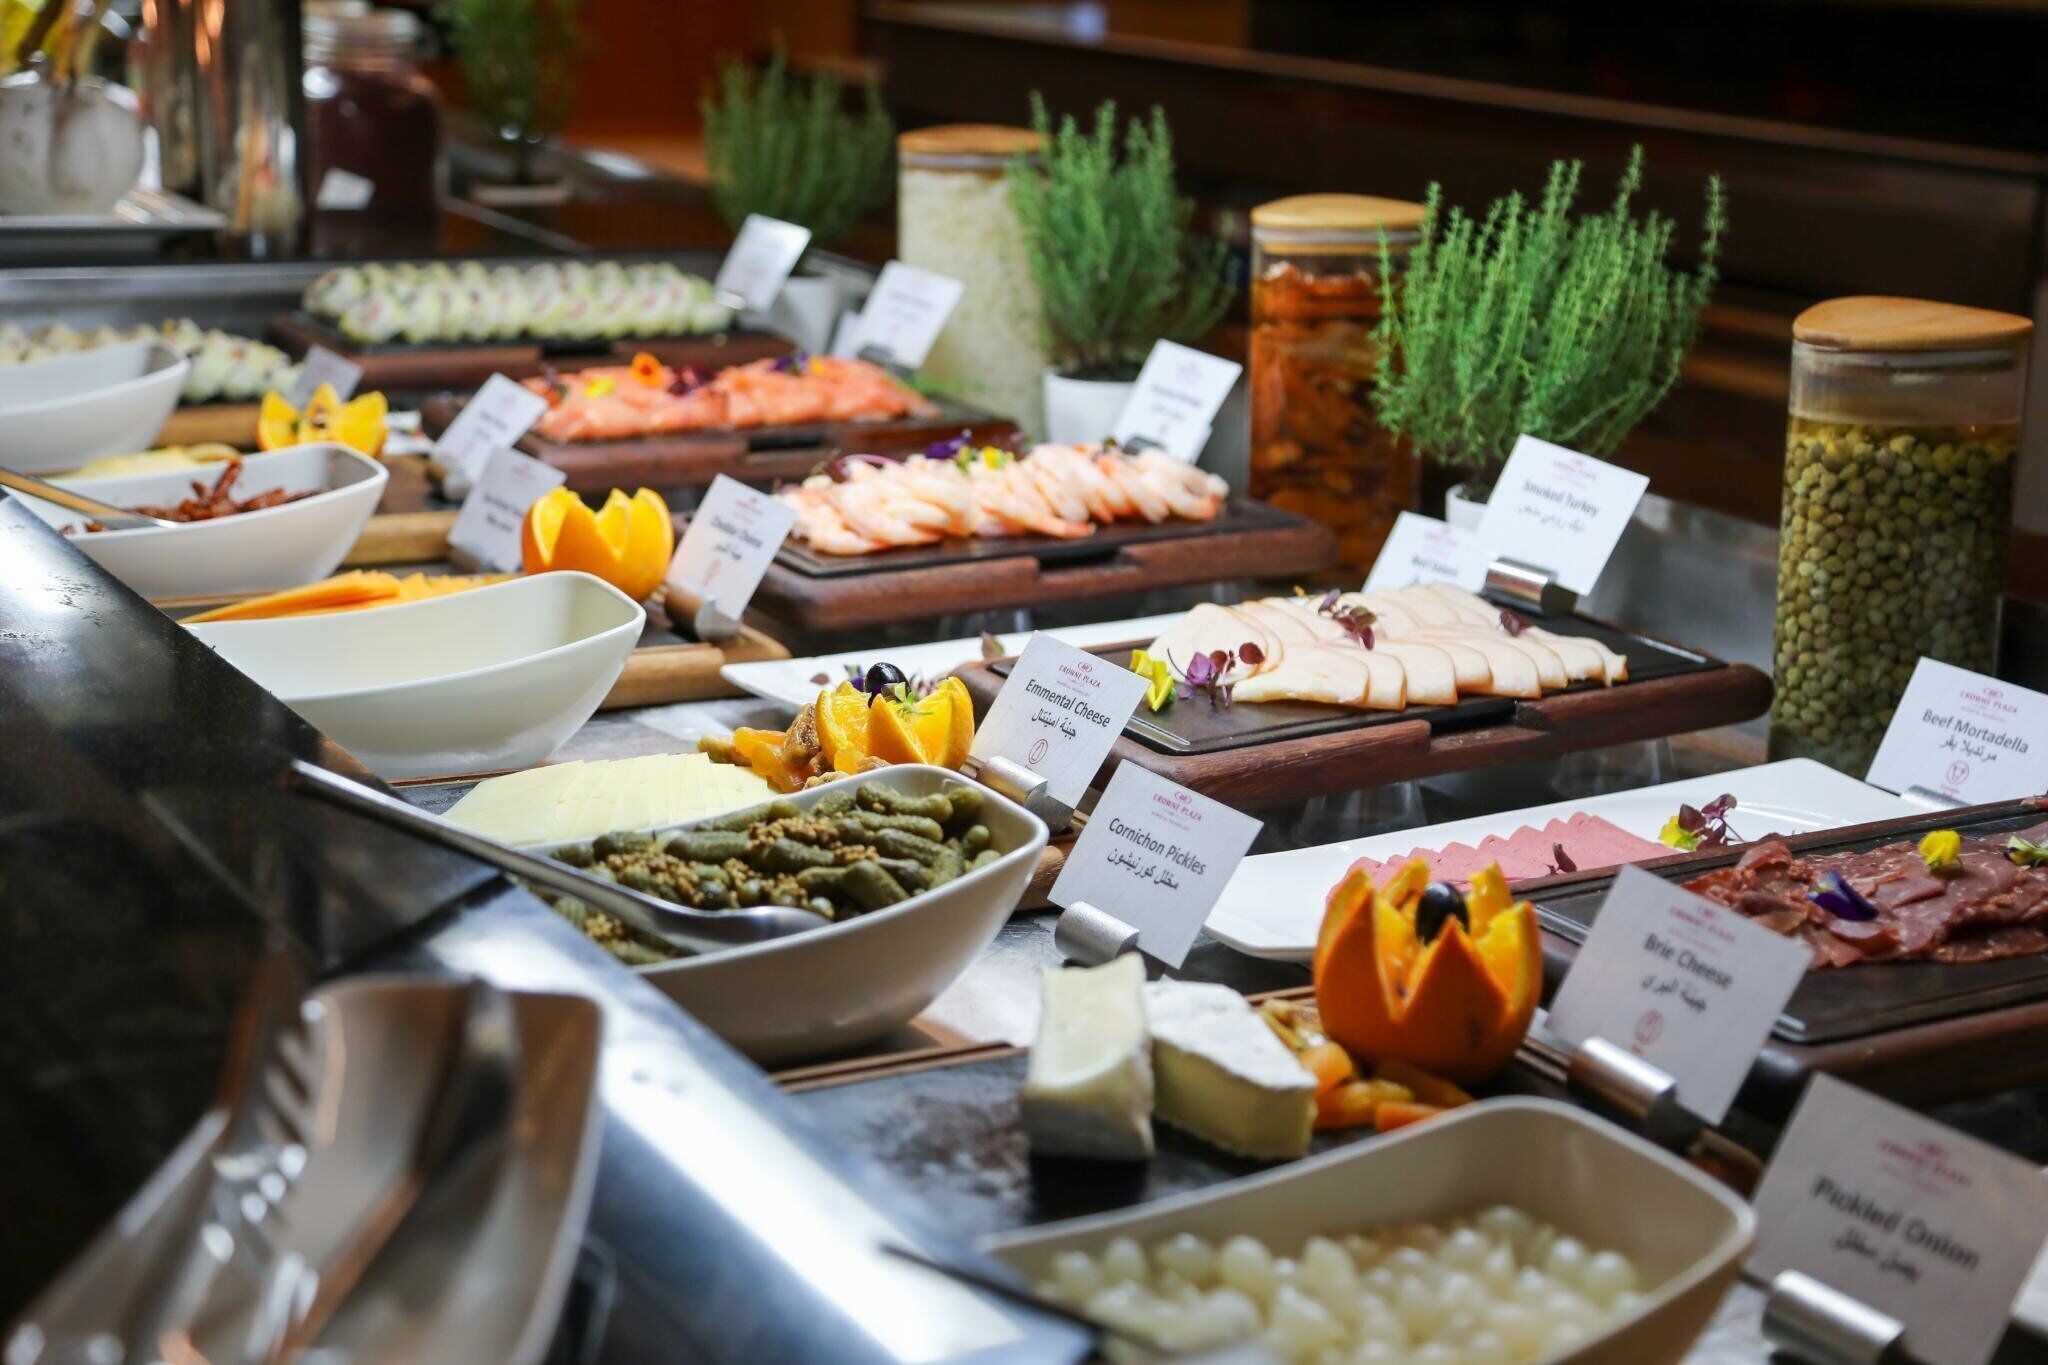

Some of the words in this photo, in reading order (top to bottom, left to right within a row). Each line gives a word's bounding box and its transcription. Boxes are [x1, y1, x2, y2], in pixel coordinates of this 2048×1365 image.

[1523, 478, 1564, 503] Smoked
[1566, 493, 1600, 520] Turkey
[1059, 664, 1081, 681] CROWNE
[1083, 675, 1101, 689] PLAZA
[1025, 678, 1075, 712] Emmental
[1074, 701, 1111, 728] Cheese
[1922, 709, 1954, 729] Beef
[1954, 720, 2029, 754] Mortadella
[1181, 806, 1202, 821] PLAZA
[1109, 818, 1165, 855] Cornichon
[1166, 845, 1207, 876] Pickles
[1644, 933, 1675, 959] Brie
[1677, 950, 1733, 990] Cheese
[1812, 1174, 1902, 1233] Pickled
[1904, 1217, 1980, 1271] Onion
